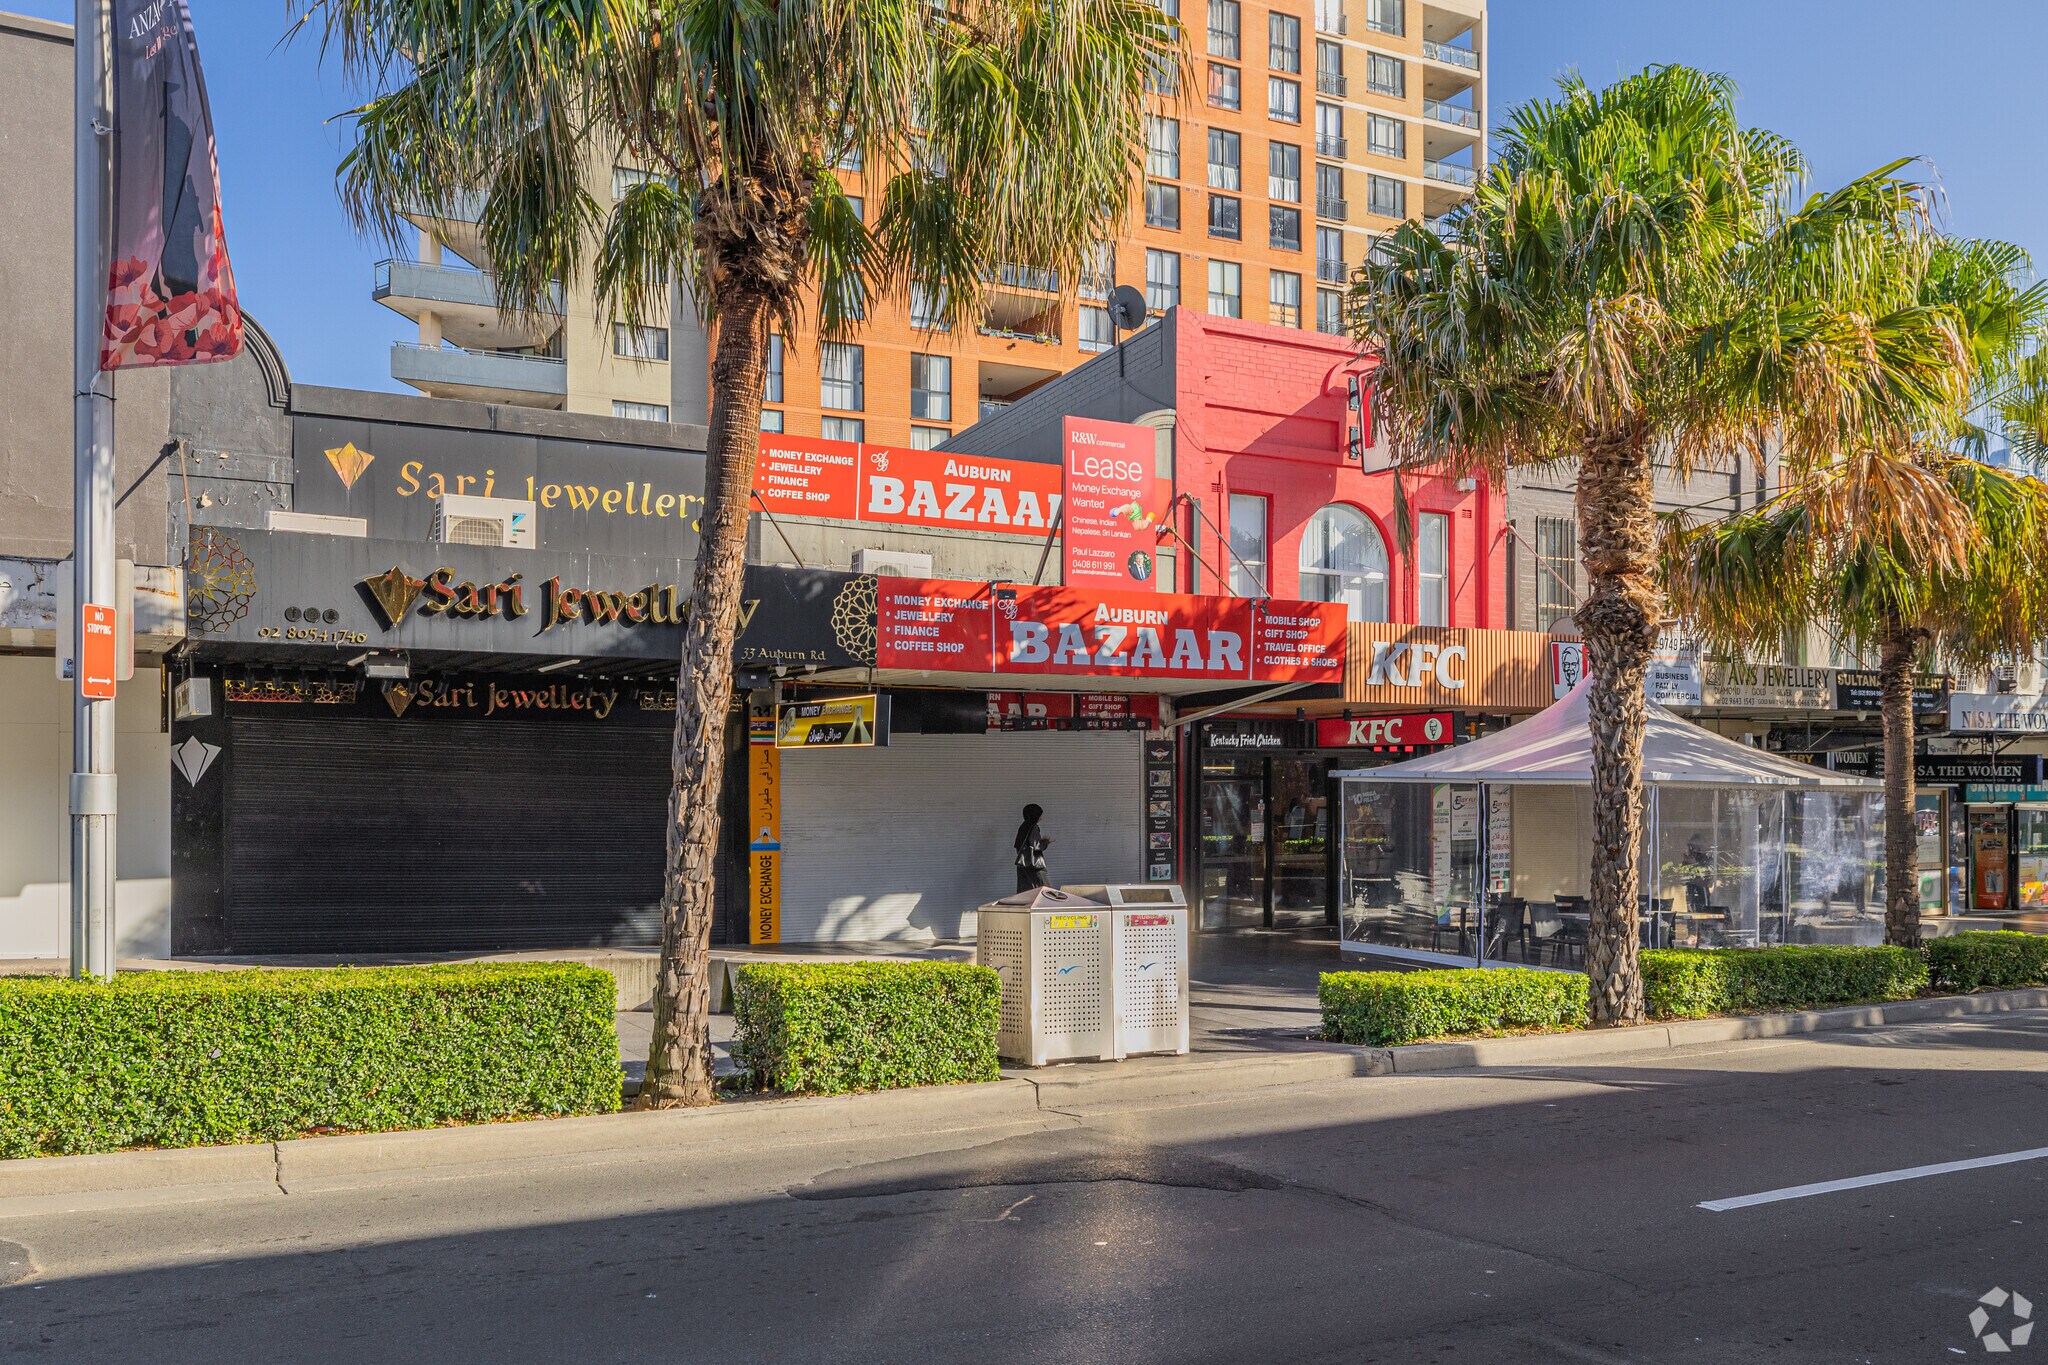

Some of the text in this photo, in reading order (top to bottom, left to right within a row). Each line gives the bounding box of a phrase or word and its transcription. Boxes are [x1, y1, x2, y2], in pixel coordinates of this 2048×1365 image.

[1072, 431, 1097, 445] R&W
[770, 449, 854, 466] MONEY EXCHANGE
[768, 462, 822, 476] JEWELLERY
[944, 459, 1011, 482] AUBURN
[1072, 450, 1142, 482] Lease
[396, 461, 495, 498] Sari
[768, 475, 808, 487] FINANCE
[768, 488, 830, 502] COFFEE SHOP
[1072, 482, 1141, 500] Money Exchange
[1072, 497, 1104, 508] Wanted
[1072, 516, 1118, 526] Chinese, Indian
[1072, 527, 1102, 536] Nepalese,
[1111, 530, 1132, 538] Lankan
[1072, 547, 1116, 558] Paul Lazzaro
[1072, 560, 1115, 570] 0408 611 991
[427, 566, 760, 641] Sari Jewelly
[894, 595, 989, 610] MONEY EXCHANGE
[94, 612, 104, 622] NO
[894, 610, 954, 622] JEWELLERY
[1094, 602, 1168, 626] AUBURN
[1265, 616, 1320, 627] MOBILE SHOP
[87, 623, 112, 635] STOPPING
[258, 626, 281, 638] 02
[894, 626, 940, 637] FINANCE
[1264, 628, 1308, 639] GIFT SHOP
[894, 641, 964, 653] COFFEE SHOP
[1010, 620, 1244, 671] BAZAAR
[1264, 642, 1326, 654] TRAVEL OFFICE
[1658, 638, 1678, 650] 9749
[741, 648, 826, 660] 33 Auburn Rd
[1264, 656, 1338, 667] CLOTHES & SHOES
[1366, 640, 1466, 690] KFC
[1656, 672, 1688, 681] BUSINESS
[1762, 668, 1830, 688] JEWELLERY
[417, 680, 618, 720] Sari Jewellery
[1656, 692, 1699, 700] COMMERCIAL
[801, 703, 852, 717] MONEY EXCHANGE
[1996, 712, 2020, 729] THE
[1347, 718, 1402, 744] KFC
[1210, 734, 1281, 748] Kentucky Fried Chicken
[1835, 752, 1869, 764] WOMEN
[1917, 765, 2022, 777] SA THE WOMEN
[1918, 814, 1937, 830] TAX
[760, 854, 772, 940] MONEY EXCHANGE
